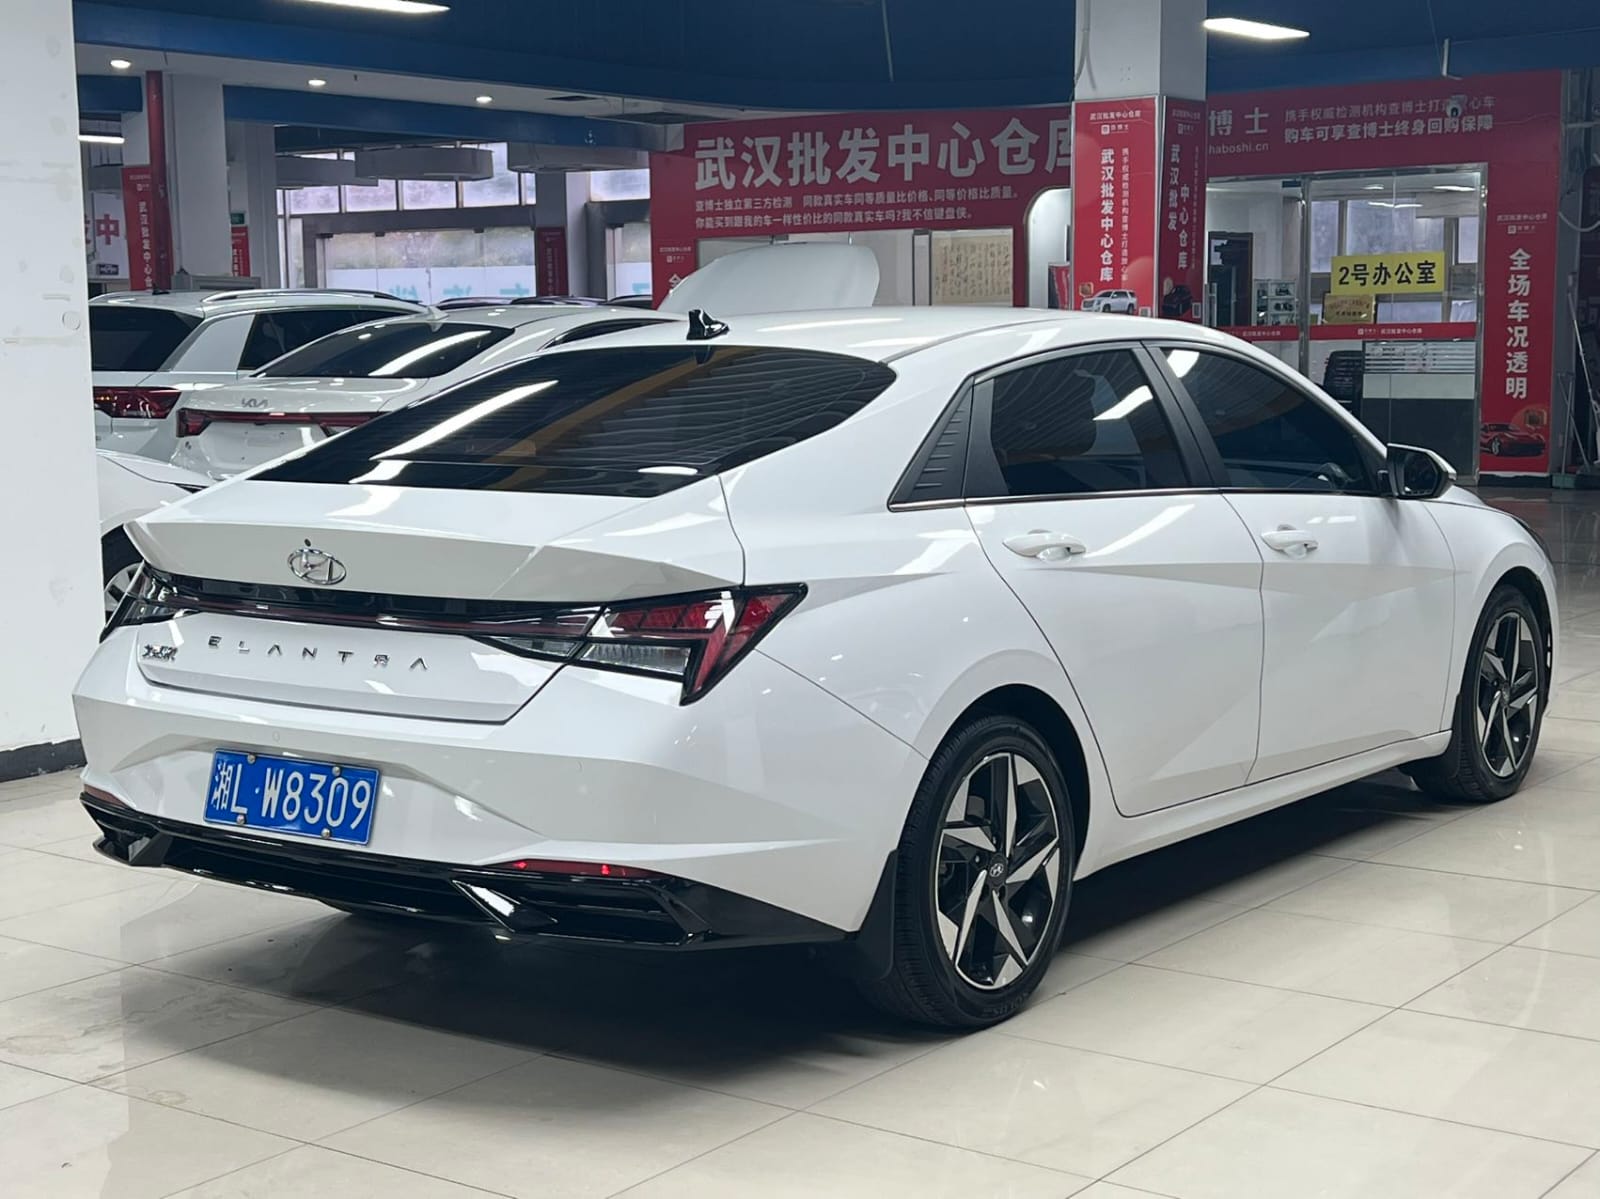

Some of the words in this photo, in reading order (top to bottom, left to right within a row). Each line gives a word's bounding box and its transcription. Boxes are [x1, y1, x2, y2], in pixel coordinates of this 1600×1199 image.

[1284, 114, 1494, 144] 购车可享查博士终身回购保障
[1100, 148, 1115, 282] 武汉批发中心仓库
[1338, 260, 1437, 287] 2号办公室
[1506, 248, 1532, 399] 全场车况透明
[207, 635, 428, 671] ELANTRA
